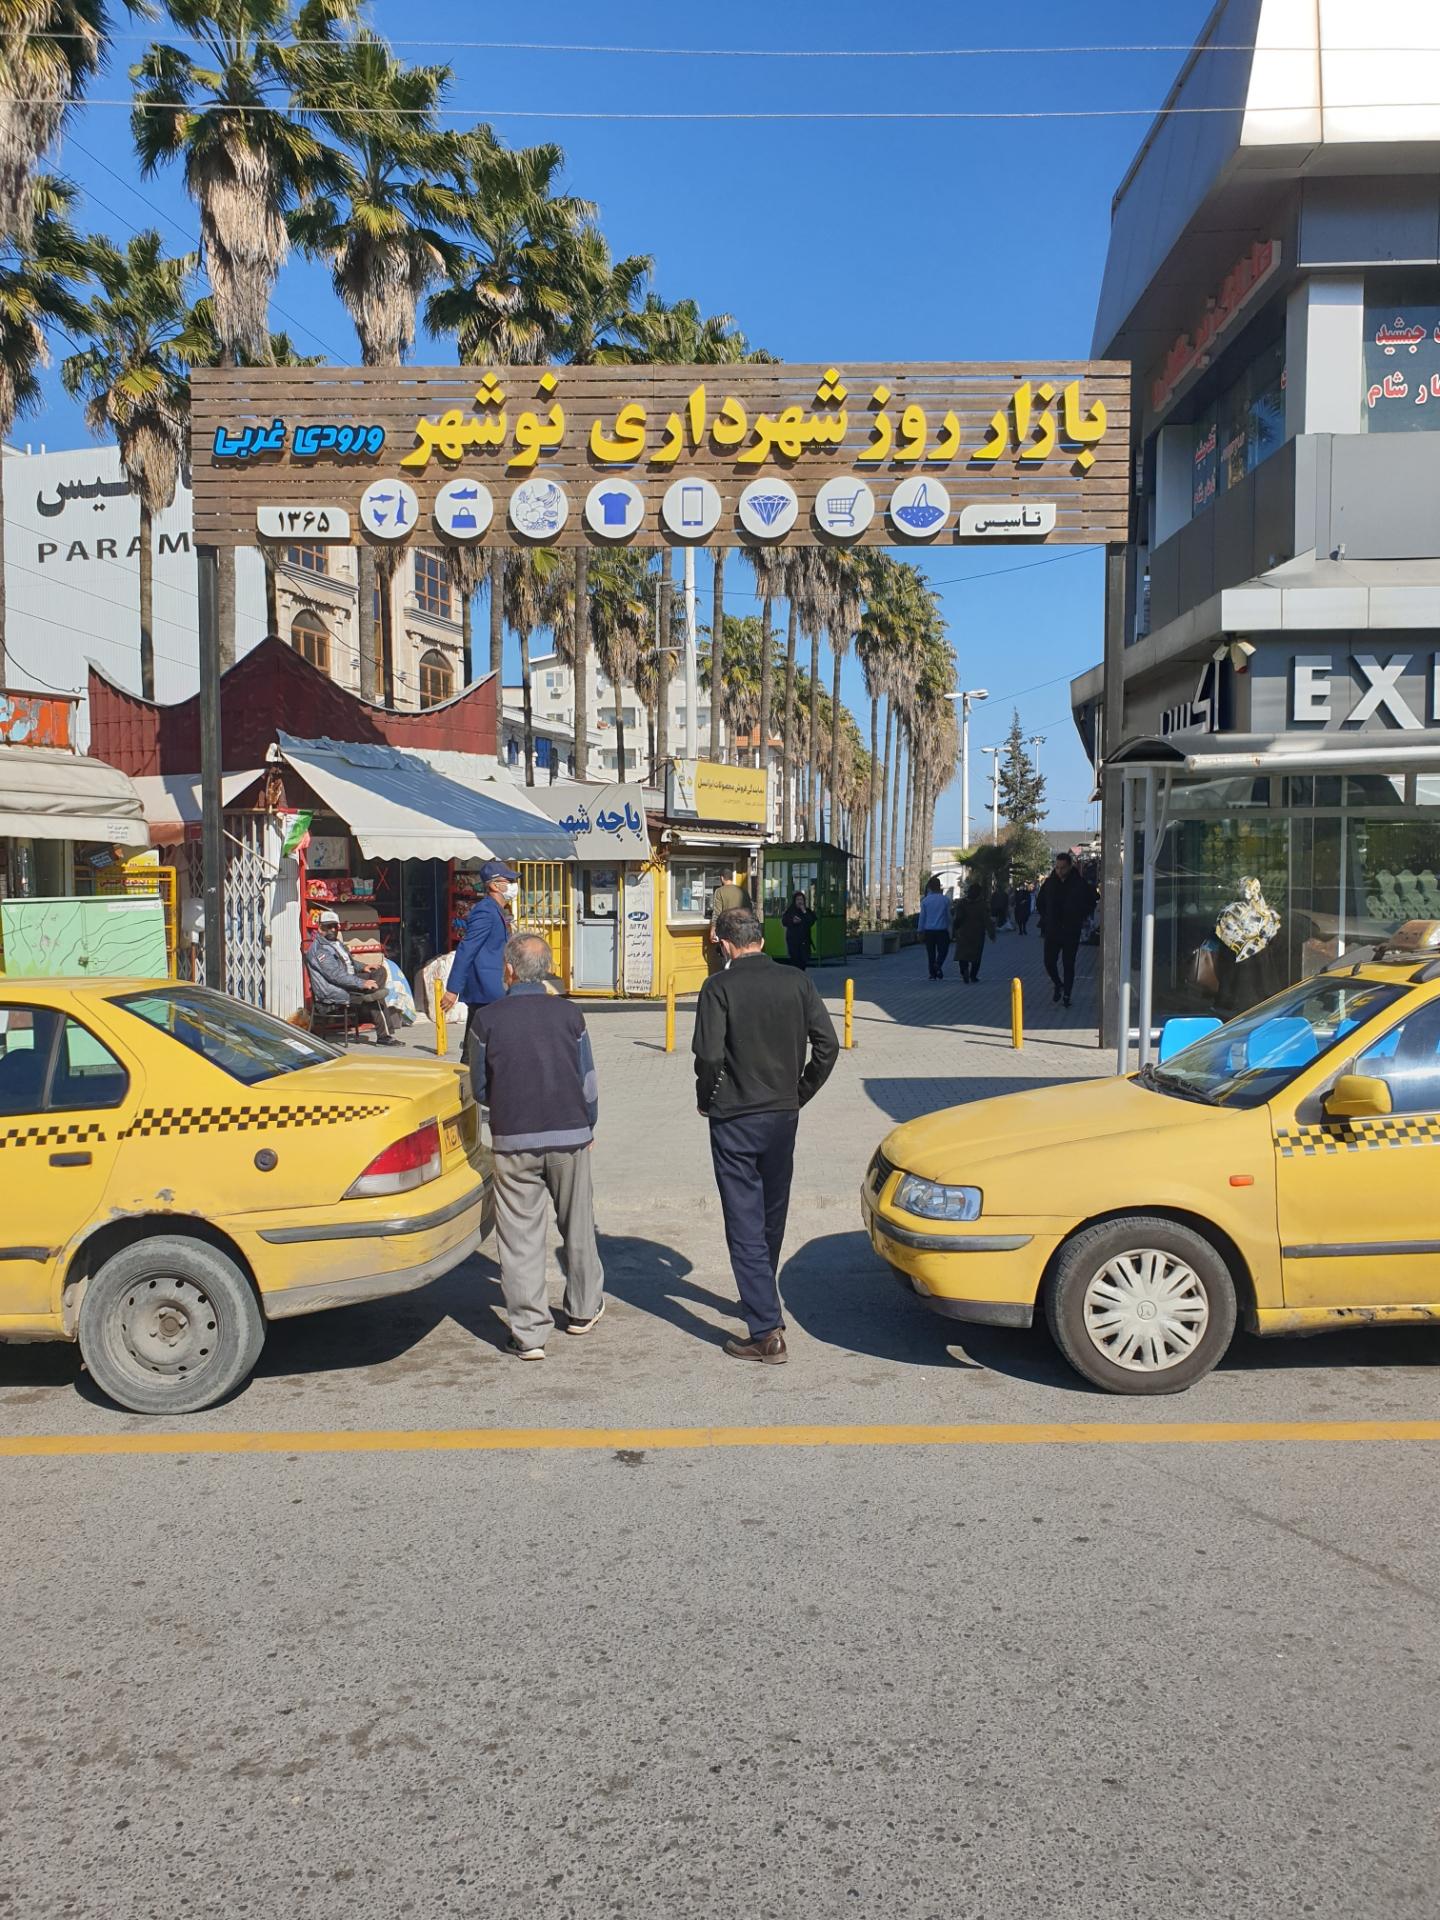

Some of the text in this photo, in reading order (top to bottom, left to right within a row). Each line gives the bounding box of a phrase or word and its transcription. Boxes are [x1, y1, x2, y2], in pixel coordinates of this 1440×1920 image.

[1367, 371, 1408, 408] شام
[401, 371, 566, 467] نوشهر
[590, 368, 848, 463] شهرداری
[858, 385, 960, 461] روز
[973, 380, 1107, 469] بازار
[213, 419, 385, 459] ورودی غربی
[277, 511, 331, 534] ۱۳۶۵
[973, 505, 1042, 534] تأسیس
[595, 802, 643, 840] باجه
